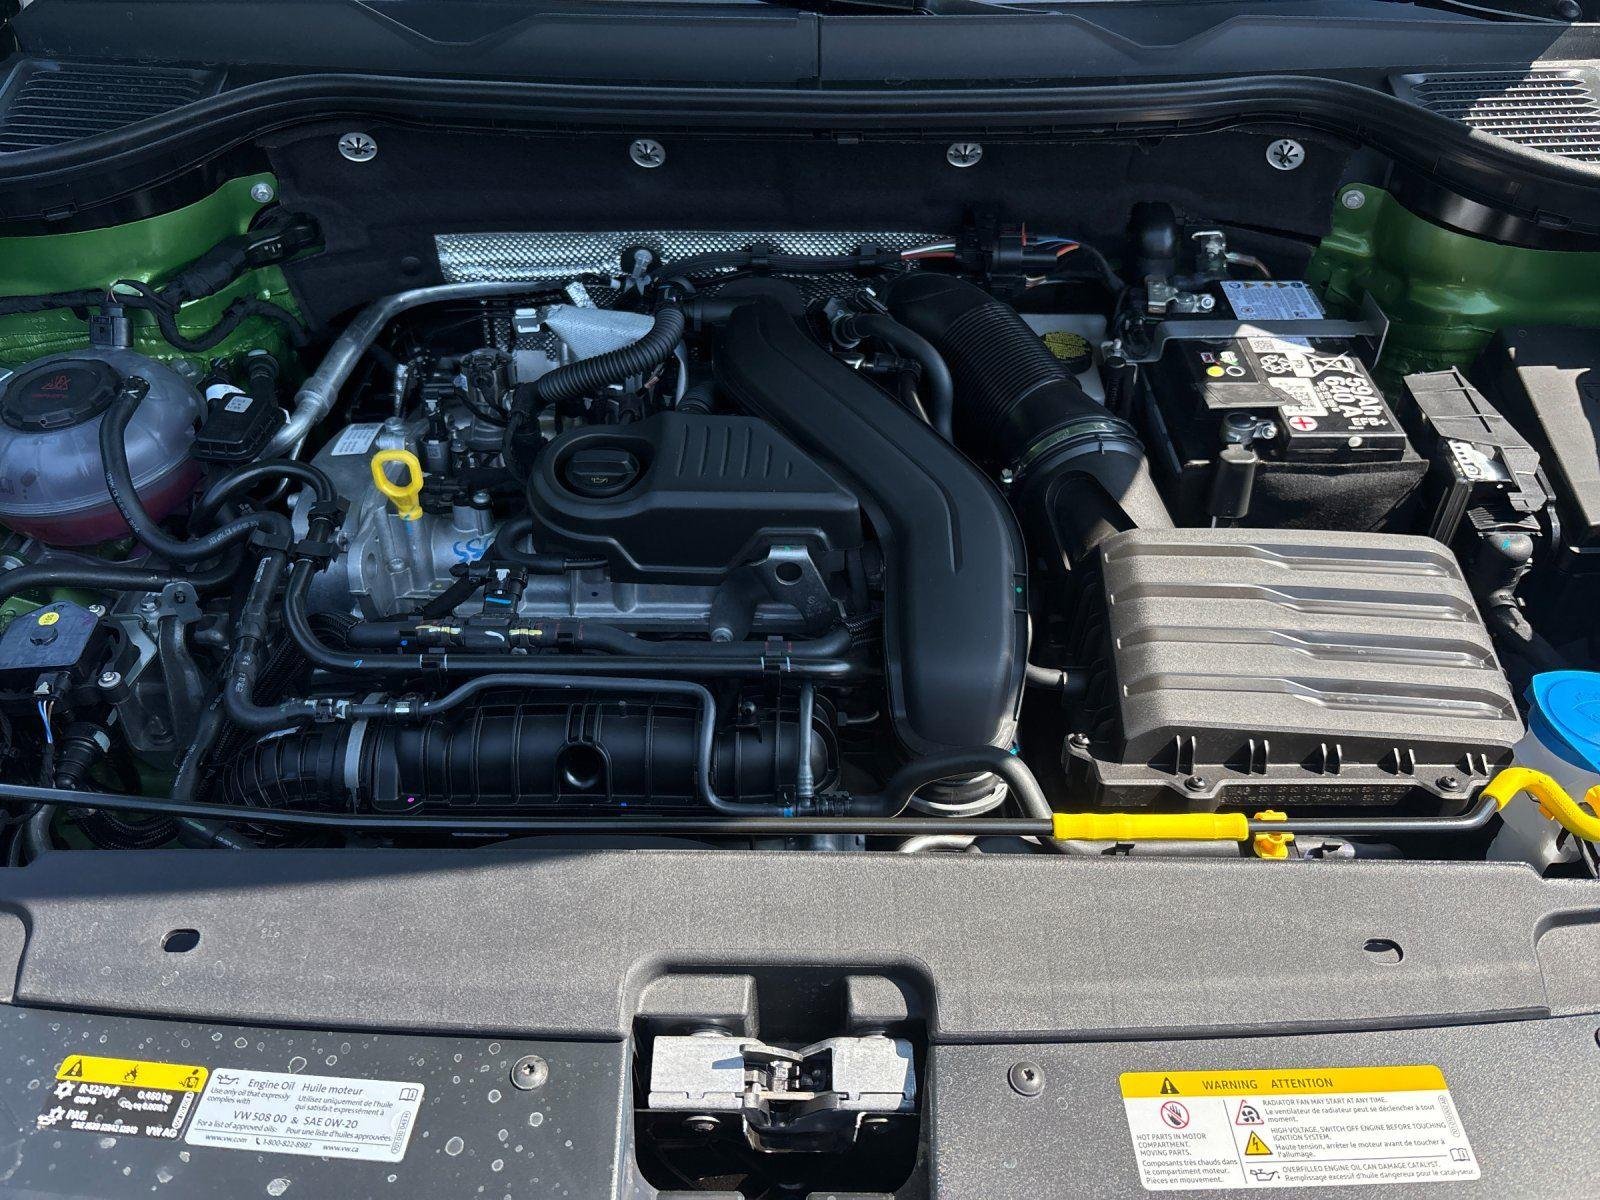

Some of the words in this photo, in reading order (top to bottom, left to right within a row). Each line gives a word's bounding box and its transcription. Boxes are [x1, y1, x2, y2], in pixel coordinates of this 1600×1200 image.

[247, 1078, 280, 1090] Engine
[281, 1081, 296, 1091] Oil
[302, 1082, 327, 1093] Huile
[328, 1085, 364, 1096] moteur
[1201, 1079, 1258, 1090] WARNING
[1271, 1077, 1334, 1089] ATTENTION
[78, 1083, 121, 1098] R-1234yf
[161, 1091, 173, 1104] kg
[206, 1095, 235, 1104] complies
[210, 1087, 223, 1095] Use
[223, 1088, 238, 1097] only
[247, 1089, 261, 1097] that
[261, 1092, 291, 1101] expressly
[322, 1096, 363, 1107] uniquement
[363, 1099, 373, 1107] de
[373, 1100, 394, 1109] l'huile
[65, 1109, 88, 1121] PAG
[294, 1104, 306, 1112] qui
[306, 1104, 332, 1113] satisfait
[333, 1106, 379, 1117] expressément
[1353, 1106, 1369, 1114] peut
[1378, 1104, 1414, 1112] déclencher
[196, 1118, 208, 1127] For
[213, 1119, 224, 1128] list
[224, 1121, 233, 1129] of
[232, 1123, 262, 1133] approved
[233, 1110, 252, 1120] VW
[252, 1112, 272, 1122] 508
[273, 1113, 288, 1123] 00
[291, 1116, 299, 1124] &
[303, 1116, 323, 1127] SAE
[324, 1118, 358, 1129] 0W-20
[145, 1125, 163, 1137] VW
[162, 1127, 178, 1138] AG
[285, 1126, 302, 1135] Pour
[315, 1129, 329, 1138] liste
[329, 1130, 354, 1139] d'huiles
[1386, 1123, 1412, 1131] BEFORE
[1412, 1122, 1447, 1130] TOUCHING
[205, 1135, 248, 1143] www.vw.com
[1136, 1133, 1151, 1141] HOT
[1151, 1133, 1173, 1141] PARTS
[1181, 1132, 1207, 1140] MOTOR
[322, 1144, 359, 1153] www.vw.ca
[1275, 1143, 1297, 1151] Haute
[1297, 1143, 1325, 1151] tension,
[1326, 1141, 1349, 1149] arrêter
[1140, 1149, 1168, 1157] MOVING
[1277, 1151, 1316, 1159] l'allumage.
[1142, 1160, 1184, 1168] Composants
[1197, 1158, 1221, 1166] chauds
[1282, 1165, 1321, 1173] OVERFILLED
[1322, 1164, 1348, 1172] ENGINE
[1349, 1163, 1362, 1171] OIL
[1362, 1163, 1377, 1171] CAN
[1377, 1162, 1407, 1170] DAMAGE
[1407, 1160, 1441, 1169] CATALYST.
[1152, 1168, 1201, 1176] compartiment
[1284, 1174, 1327, 1183] Remplissage
[1379, 1171, 1415, 1180] dangereux
[1415, 1170, 1431, 1178] pour
[1146, 1176, 1169, 1184] Pièces
